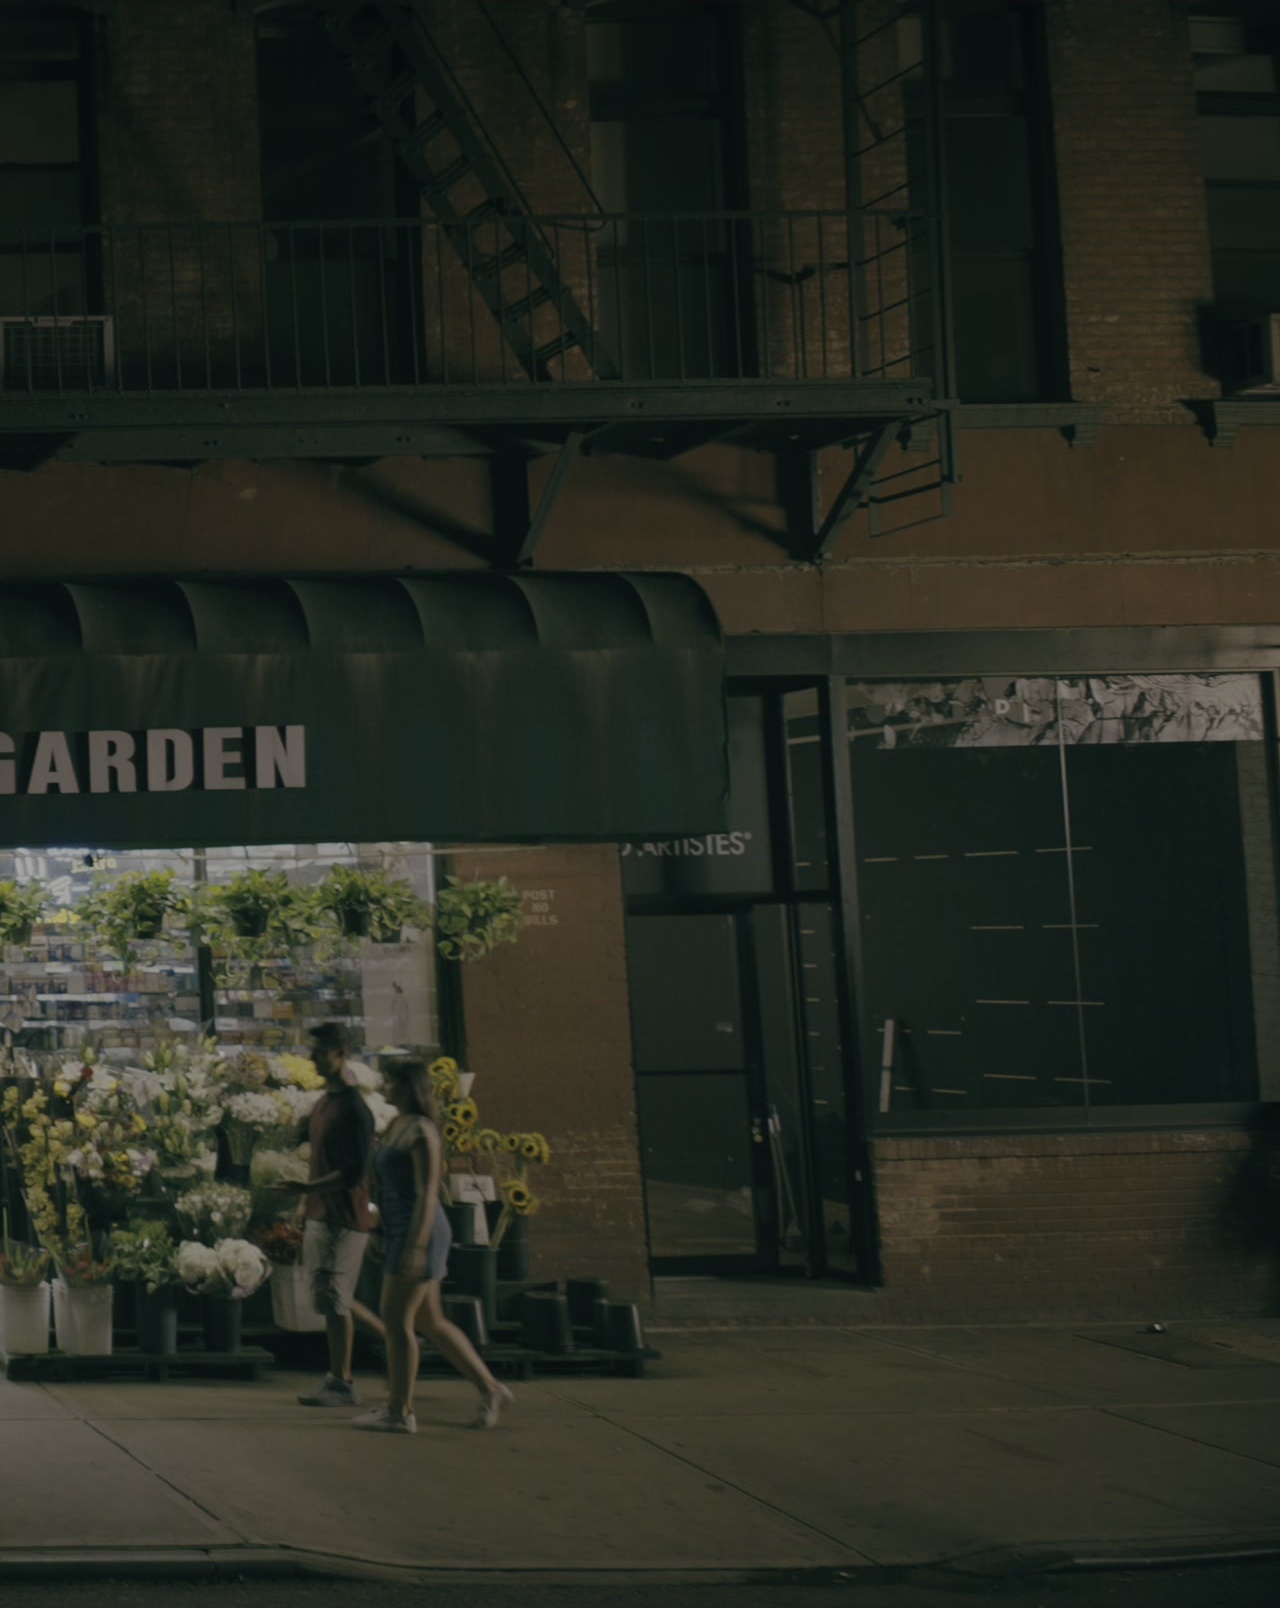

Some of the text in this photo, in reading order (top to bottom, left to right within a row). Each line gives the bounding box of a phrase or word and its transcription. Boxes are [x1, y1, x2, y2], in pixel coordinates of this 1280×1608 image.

[522, 889, 555, 901] POST
[531, 902, 549, 913] NO
[524, 914, 558, 926] BILLS
